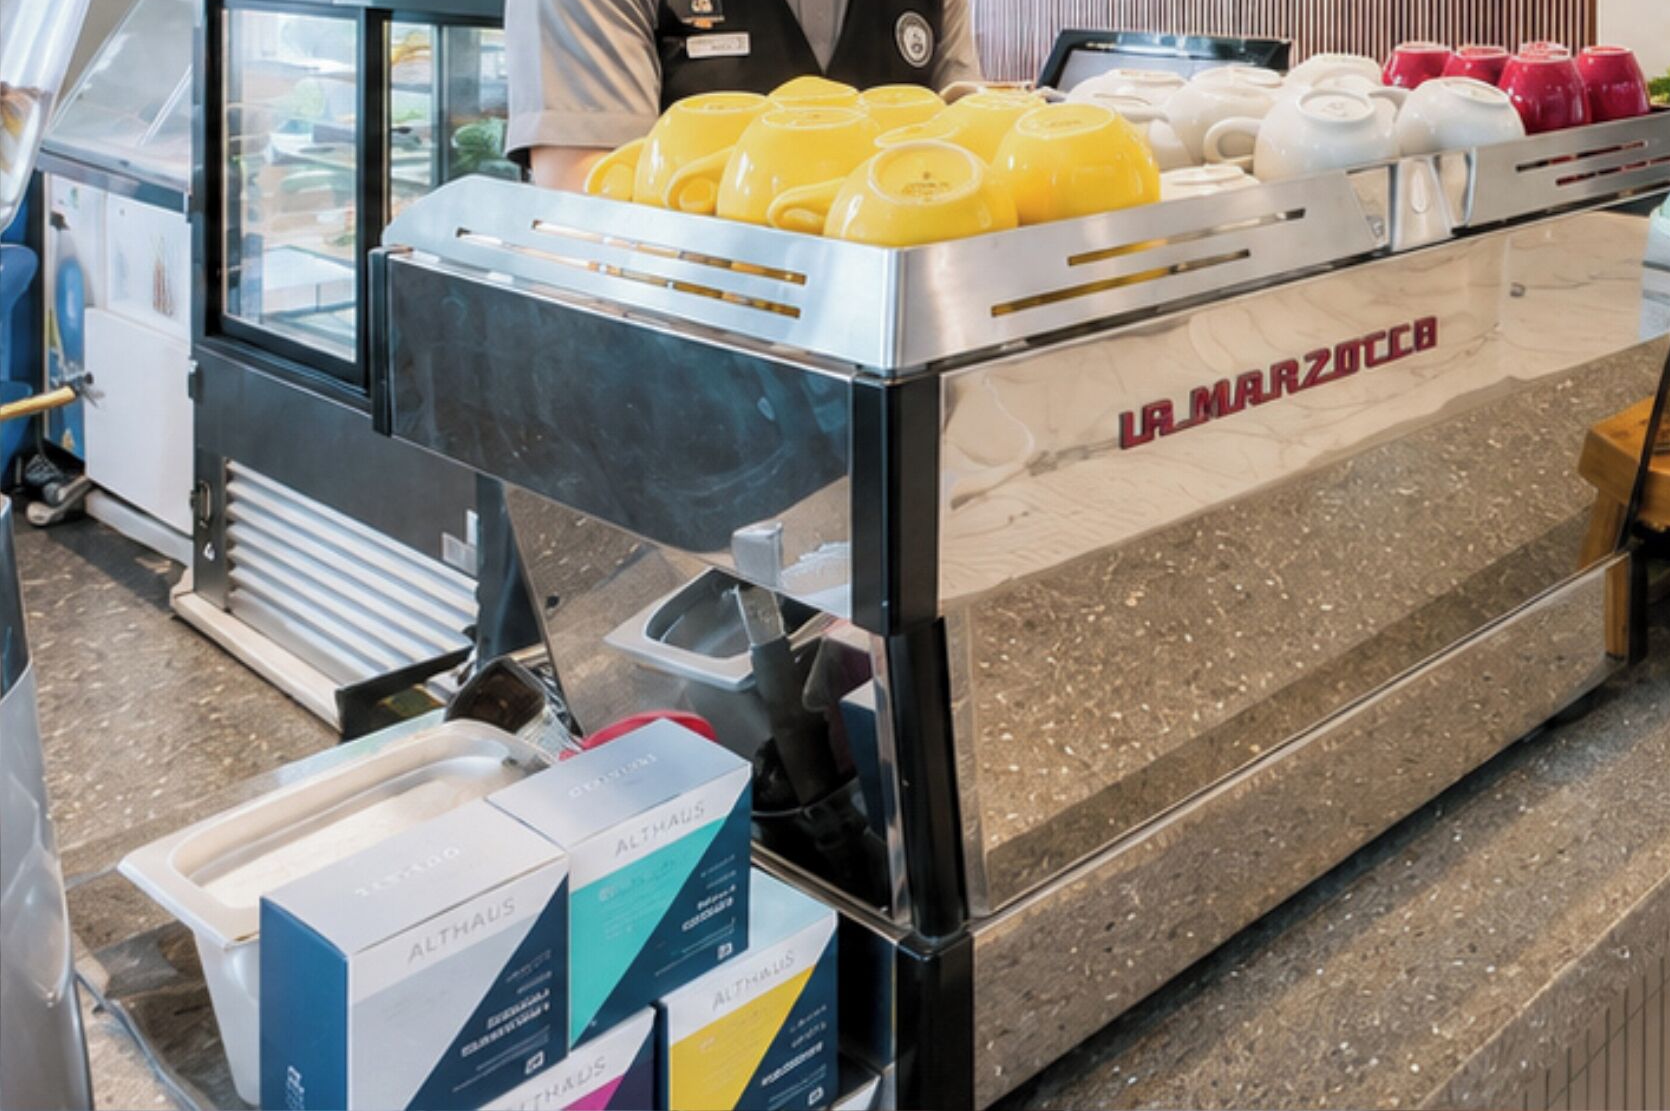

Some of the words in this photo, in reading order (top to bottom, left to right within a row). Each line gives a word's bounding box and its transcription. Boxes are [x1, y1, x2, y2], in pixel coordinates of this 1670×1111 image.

[1118, 398, 1175, 450] LA
[1188, 316, 1438, 424] MARZOCCO
[614, 800, 705, 858] ALTHAUS
[407, 896, 516, 965] ALTHAUS
[711, 948, 796, 1012] ALTHAUS
[513, 1054, 606, 1111] THAUS
